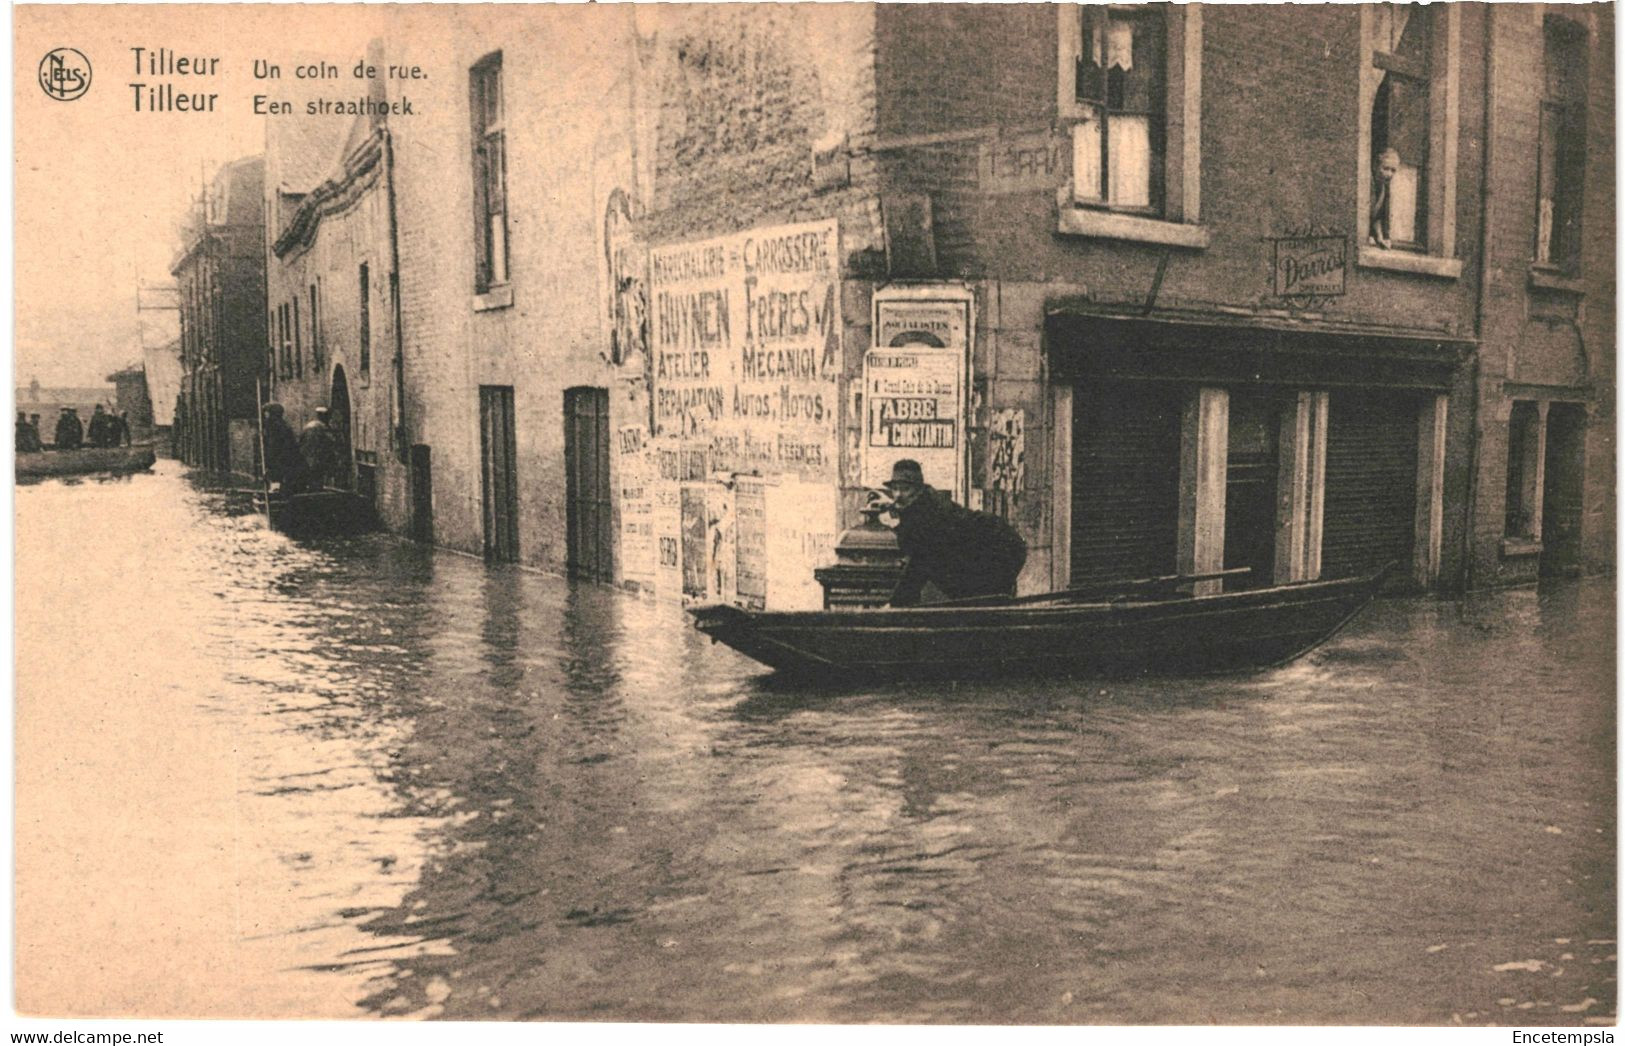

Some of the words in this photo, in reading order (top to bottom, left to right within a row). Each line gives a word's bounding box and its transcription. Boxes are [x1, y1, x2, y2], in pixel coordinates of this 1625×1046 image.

[658, 288, 731, 348] HUYNEN
[657, 351, 710, 380] ATELIER
[892, 423, 954, 447] CONSTANTIN
